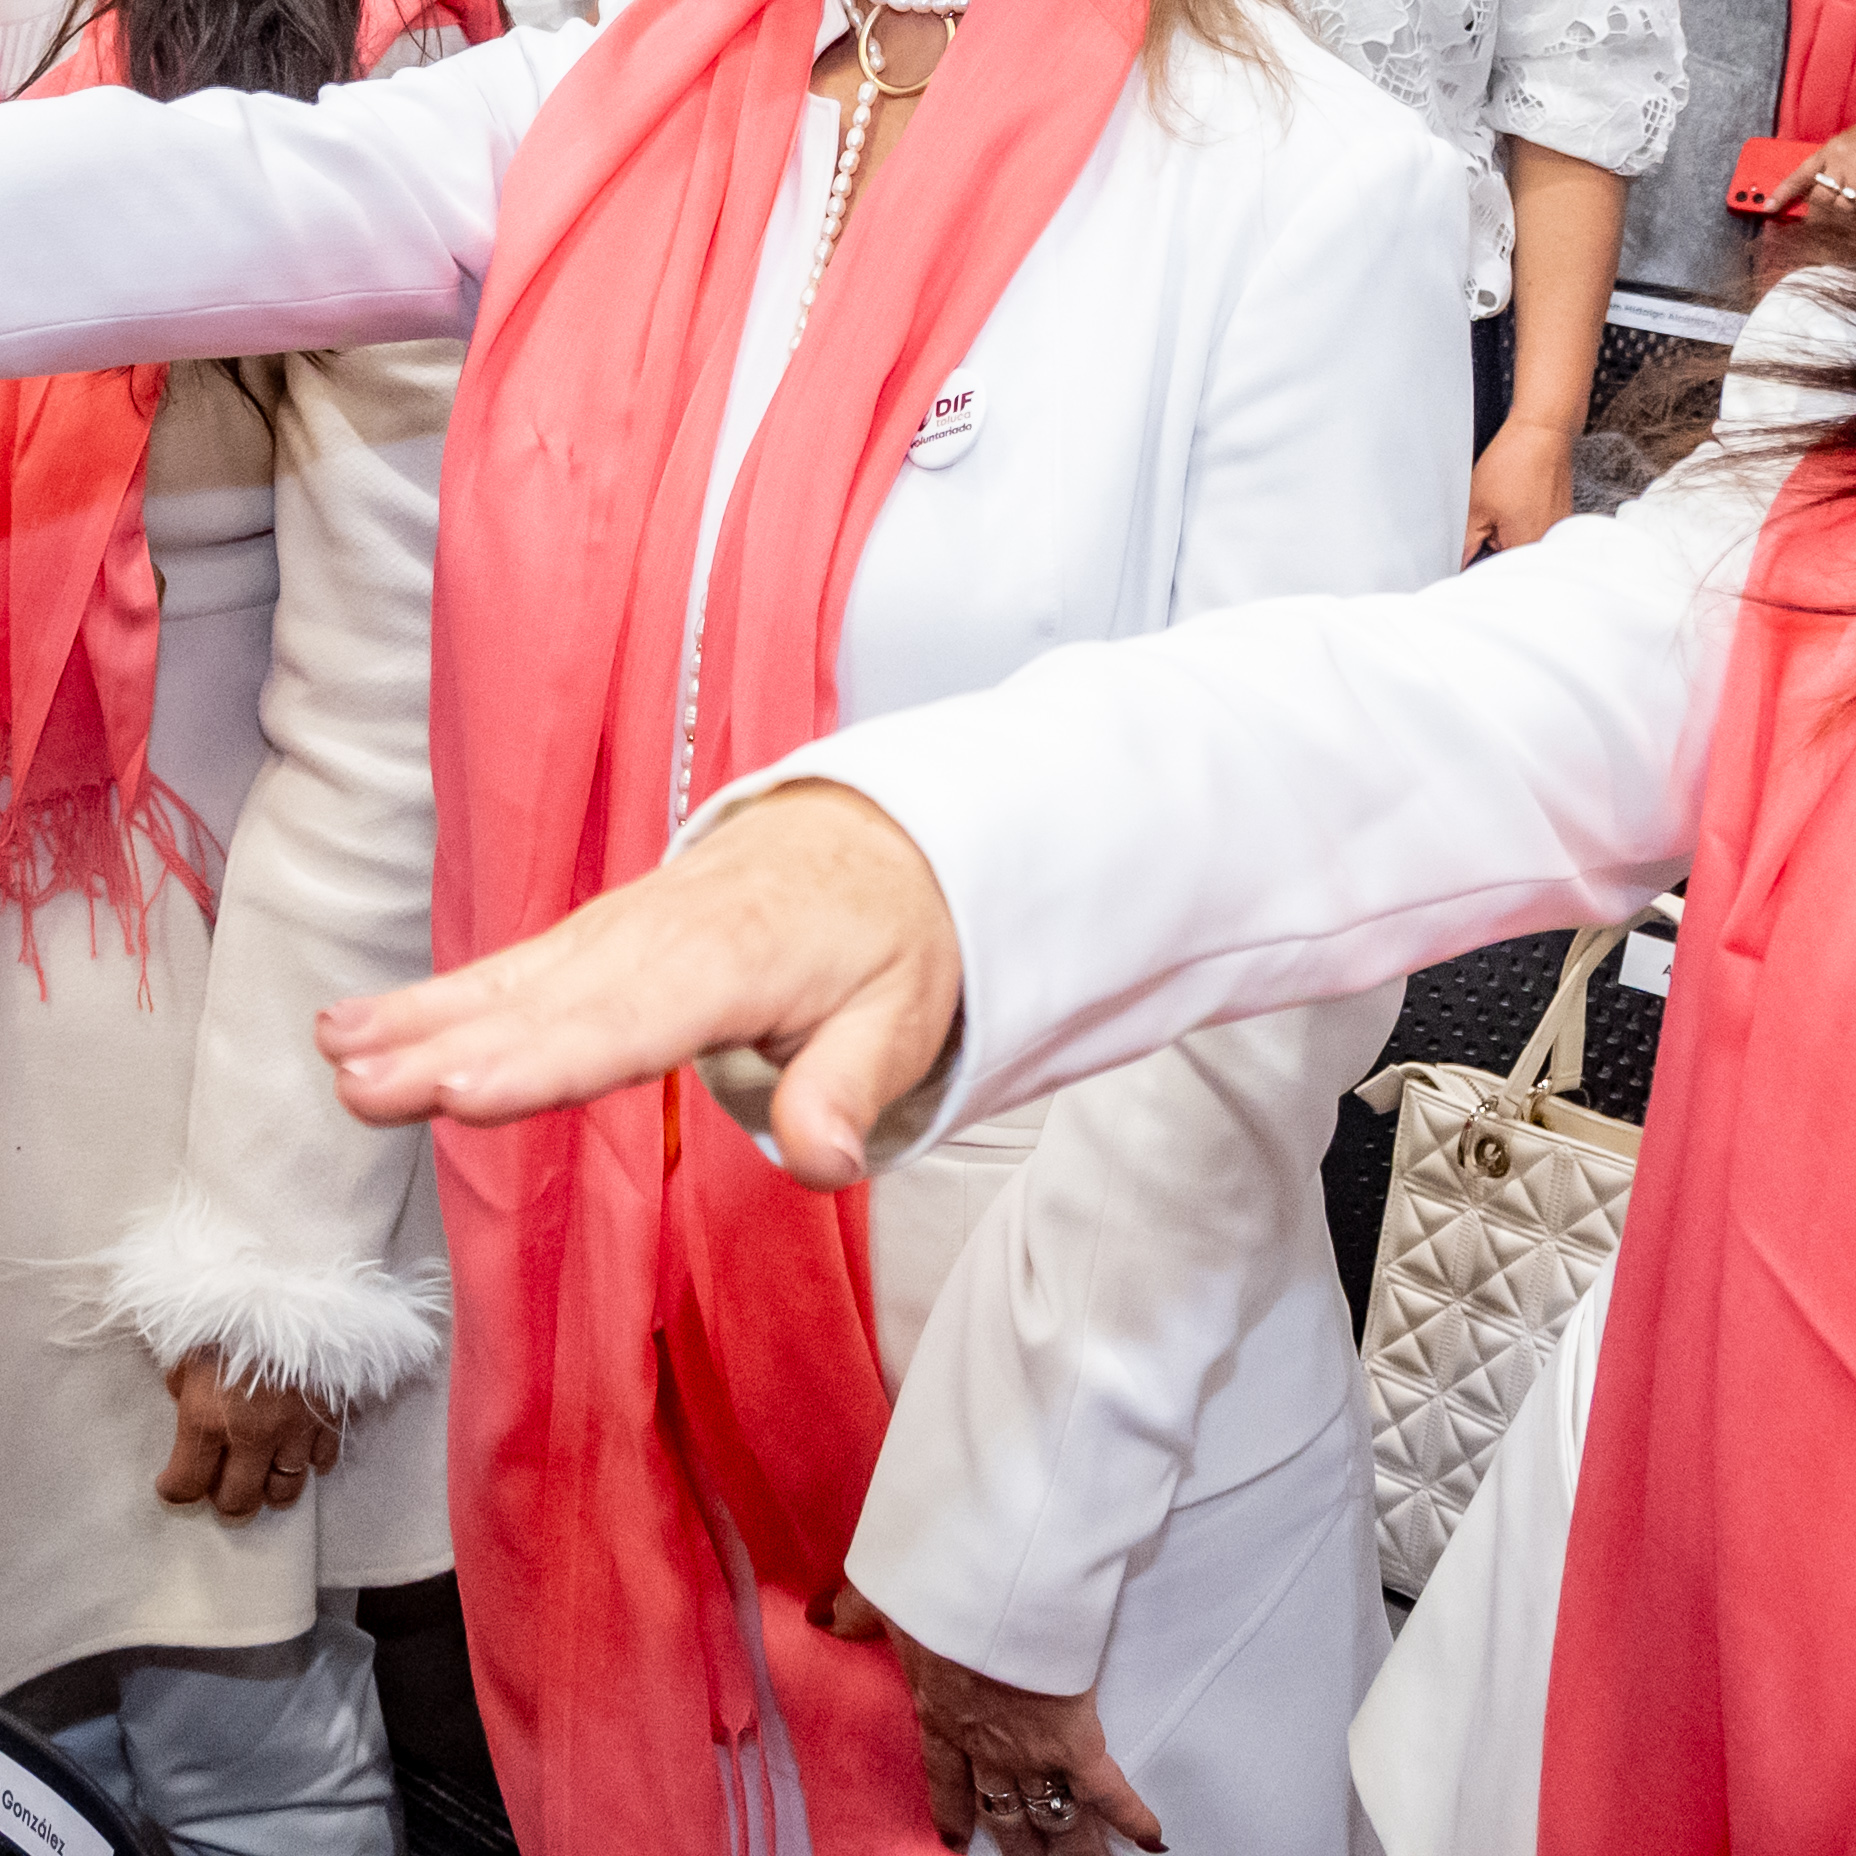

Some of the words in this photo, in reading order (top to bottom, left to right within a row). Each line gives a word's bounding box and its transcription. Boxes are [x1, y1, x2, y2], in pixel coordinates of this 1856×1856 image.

[935, 390, 975, 418] DIF
[936, 411, 971, 428] toluca
[1, 1789, 66, 1856] González
